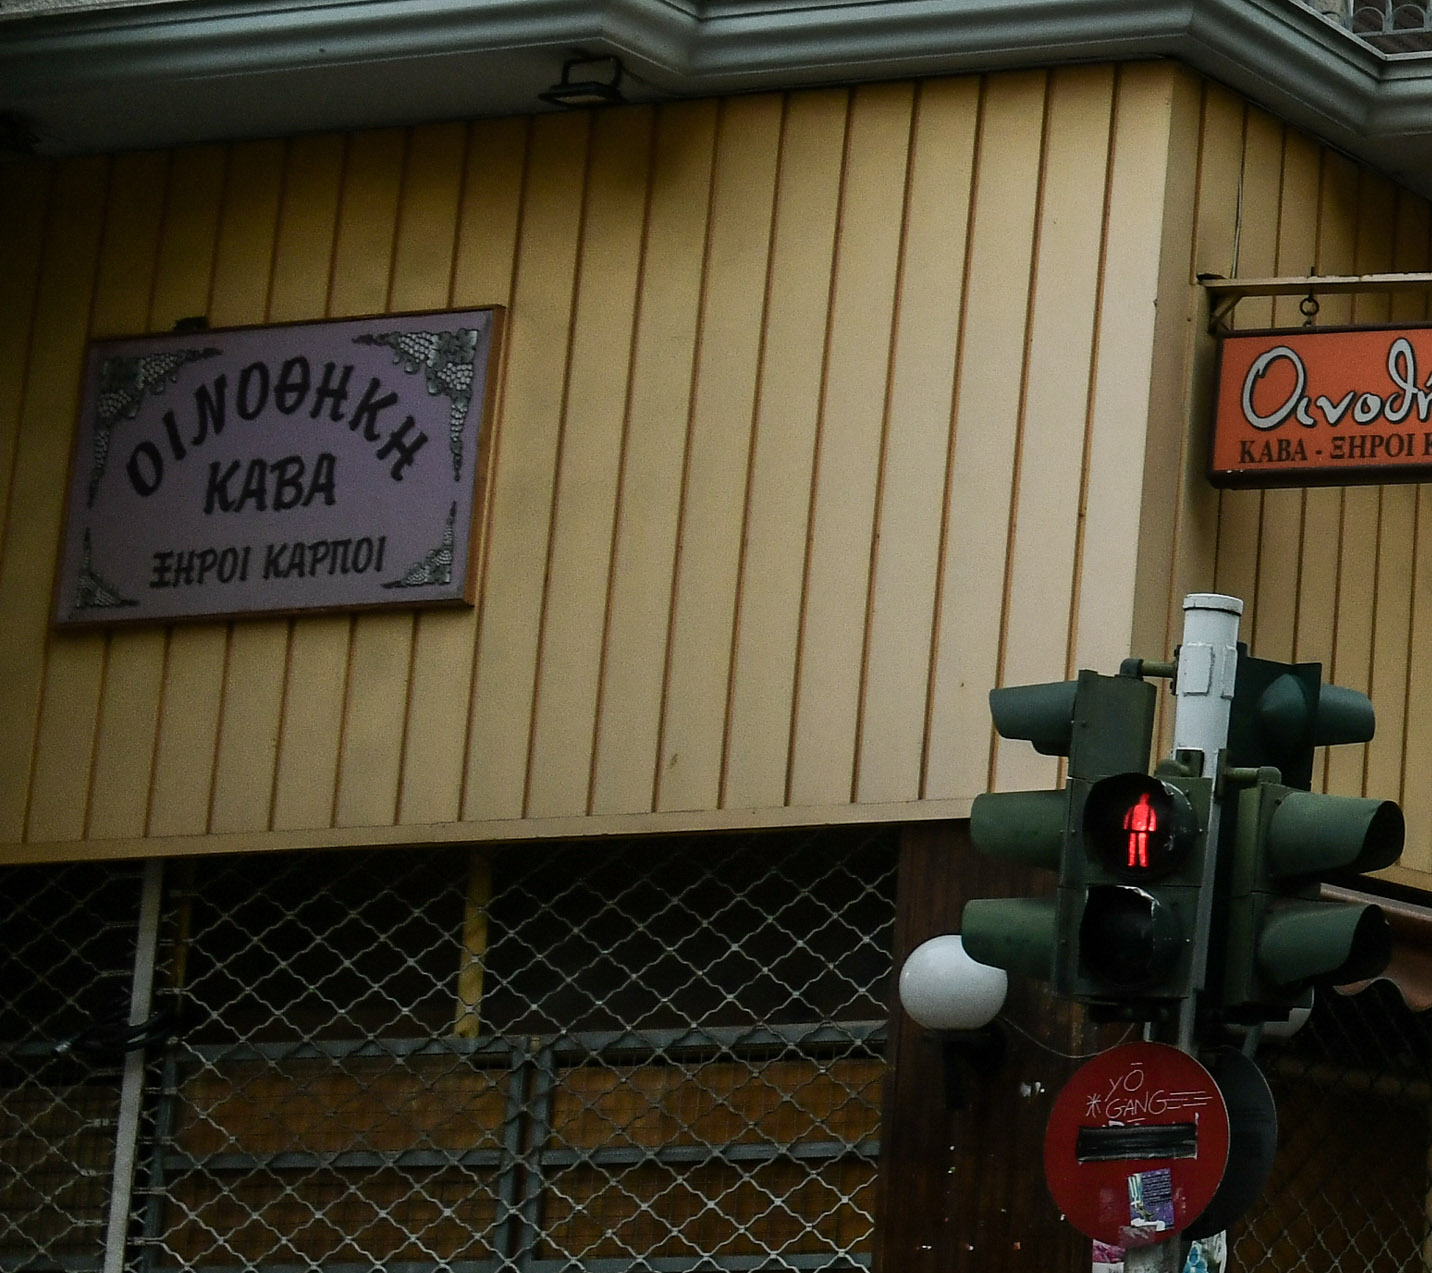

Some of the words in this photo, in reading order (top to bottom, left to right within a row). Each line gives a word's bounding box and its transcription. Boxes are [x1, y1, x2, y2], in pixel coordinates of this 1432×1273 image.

[126, 355, 429, 496] ΟΙΝΟΘΗΚΗ
[1239, 436, 1308, 464] ΚΑΒΑ
[1330, 434, 1416, 460] ΞΗΡΟΙ
[204, 453, 337, 514] ΚΑΒΑ
[150, 547, 249, 589] ΞΗΡΟΙ
[262, 536, 386, 580] ΚΑΡΠΟΙ
